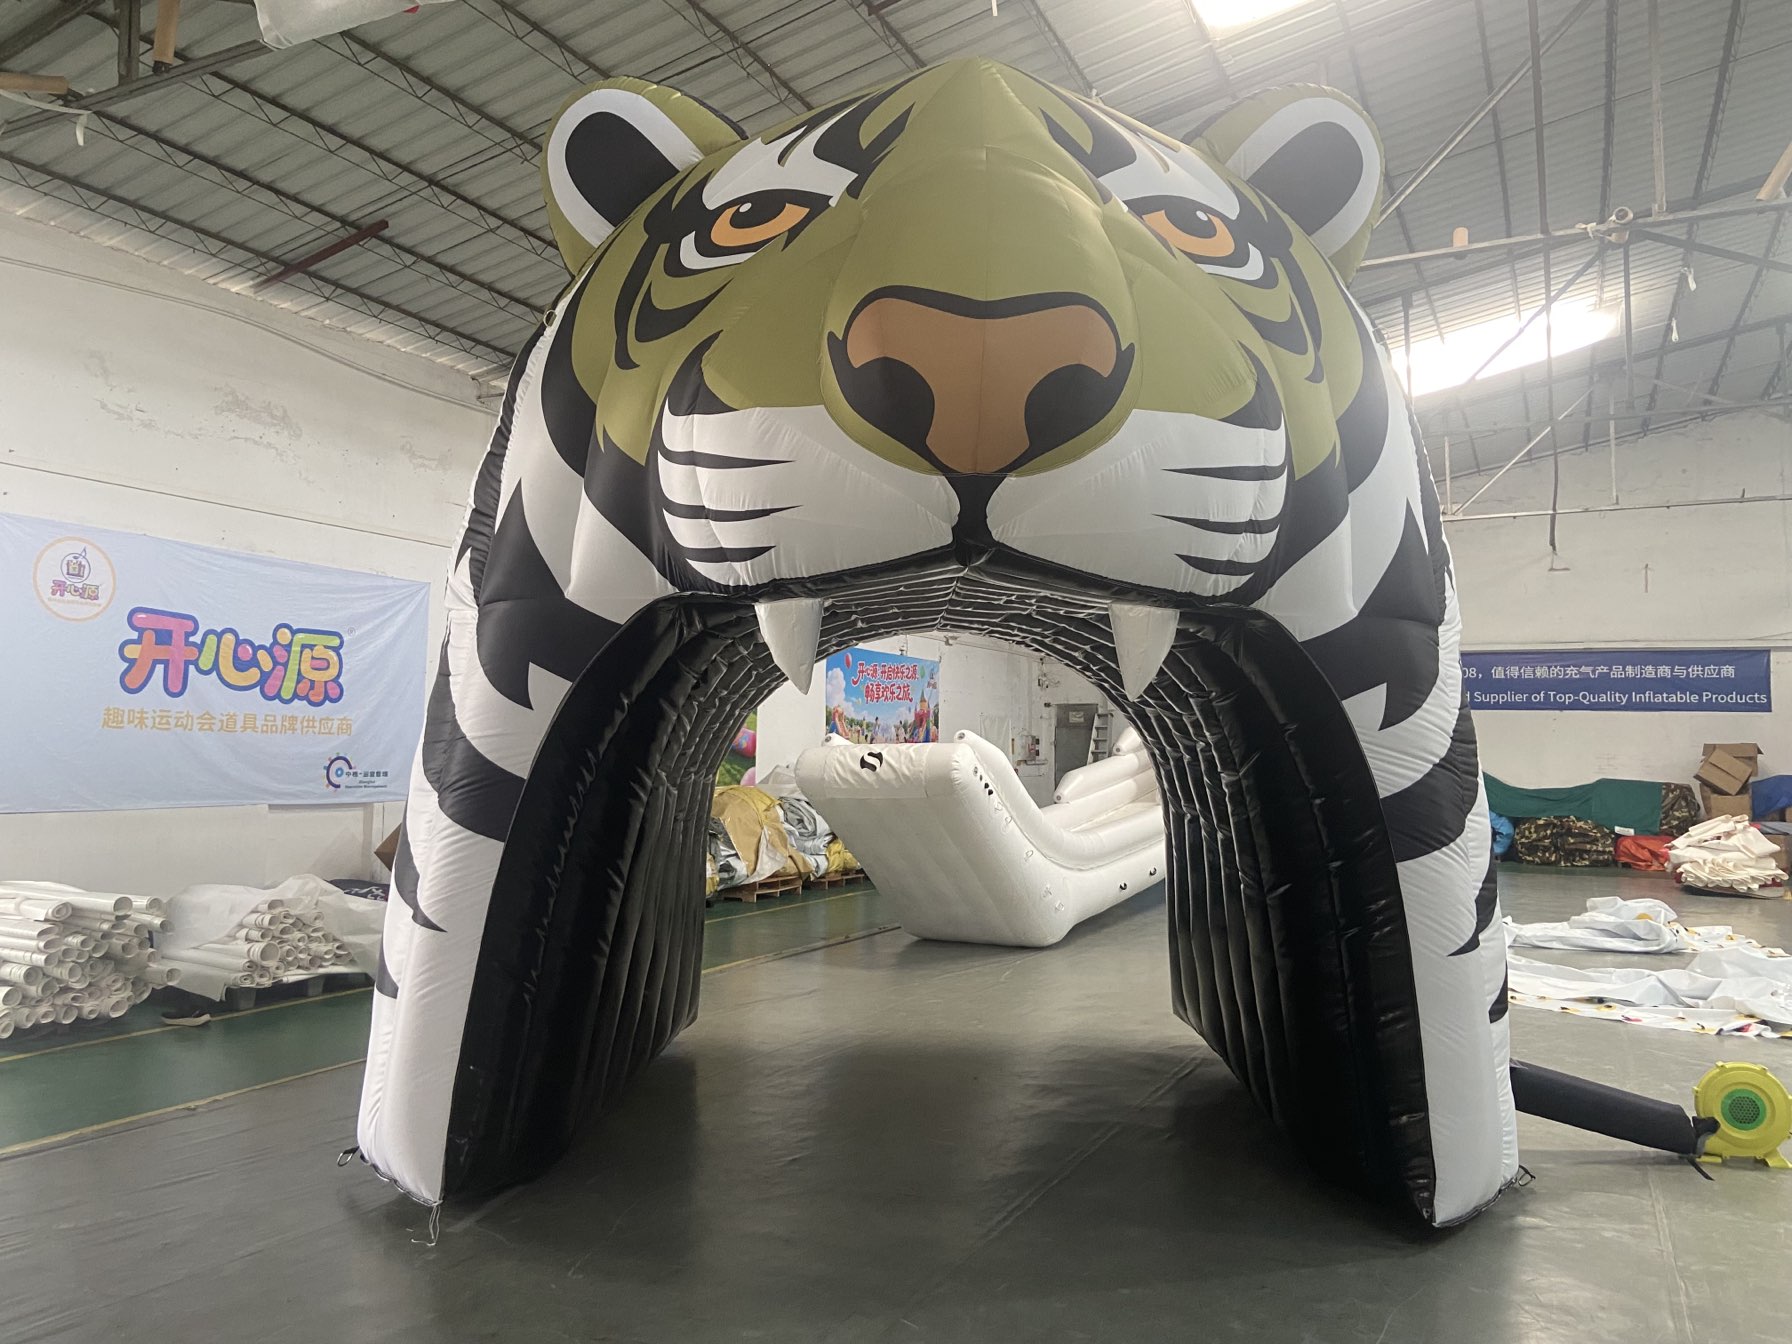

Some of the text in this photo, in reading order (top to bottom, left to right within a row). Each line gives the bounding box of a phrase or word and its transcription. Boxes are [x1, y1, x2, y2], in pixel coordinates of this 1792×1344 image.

[118, 606, 344, 707] 开心源
[1474, 691, 1528, 705] Supplier
[1531, 690, 1545, 702] of
[1548, 691, 1629, 705] Top-Quality
[1632, 690, 1699, 703] Inflatable
[1702, 691, 1768, 703] Products
[101, 706, 353, 737] 趣味运动会道具品牌供应商
